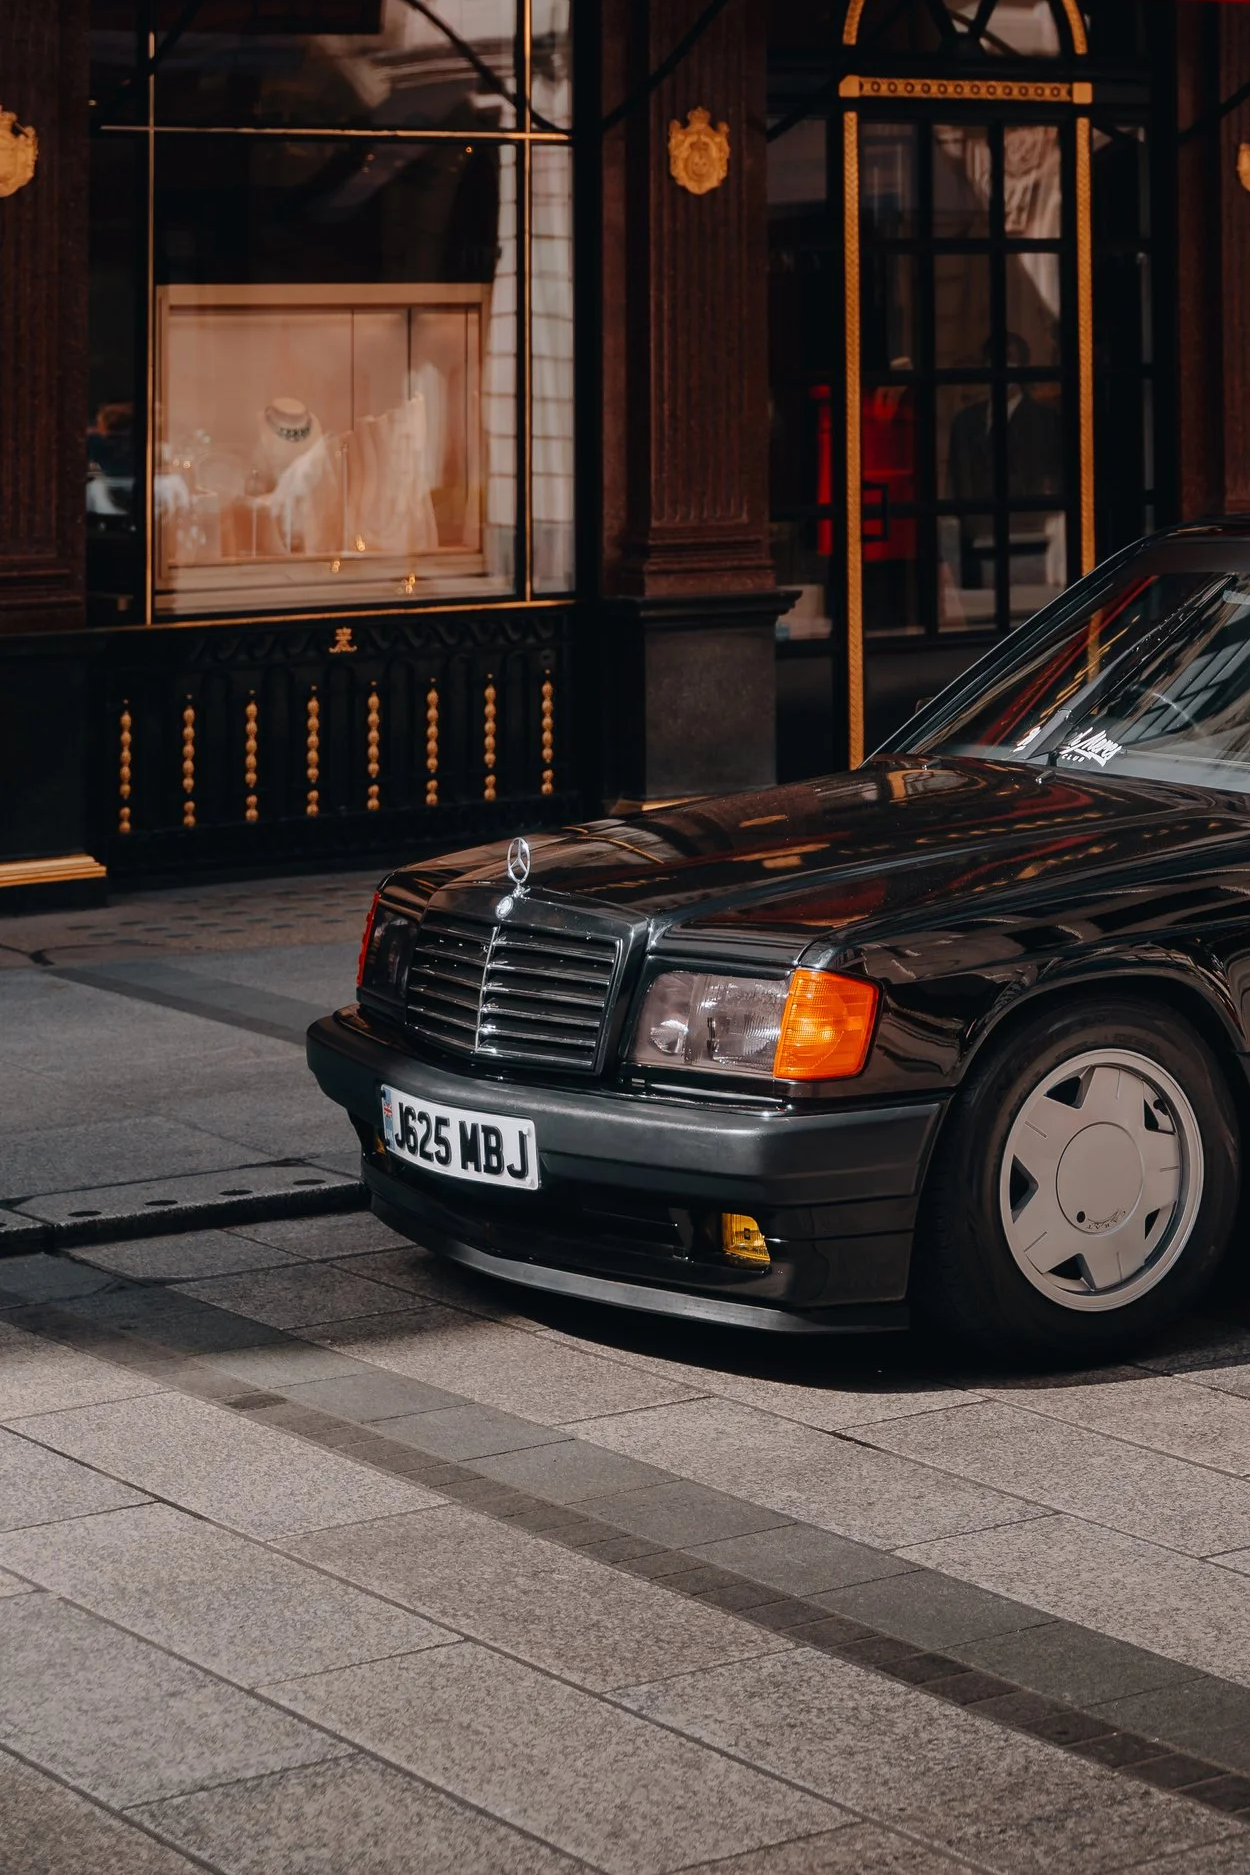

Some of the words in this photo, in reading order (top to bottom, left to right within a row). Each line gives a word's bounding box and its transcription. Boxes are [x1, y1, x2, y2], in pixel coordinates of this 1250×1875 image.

[1061, 753, 1085, 763] CLUB
[395, 1102, 453, 1166] J625
[458, 1120, 530, 1179] MBJ
